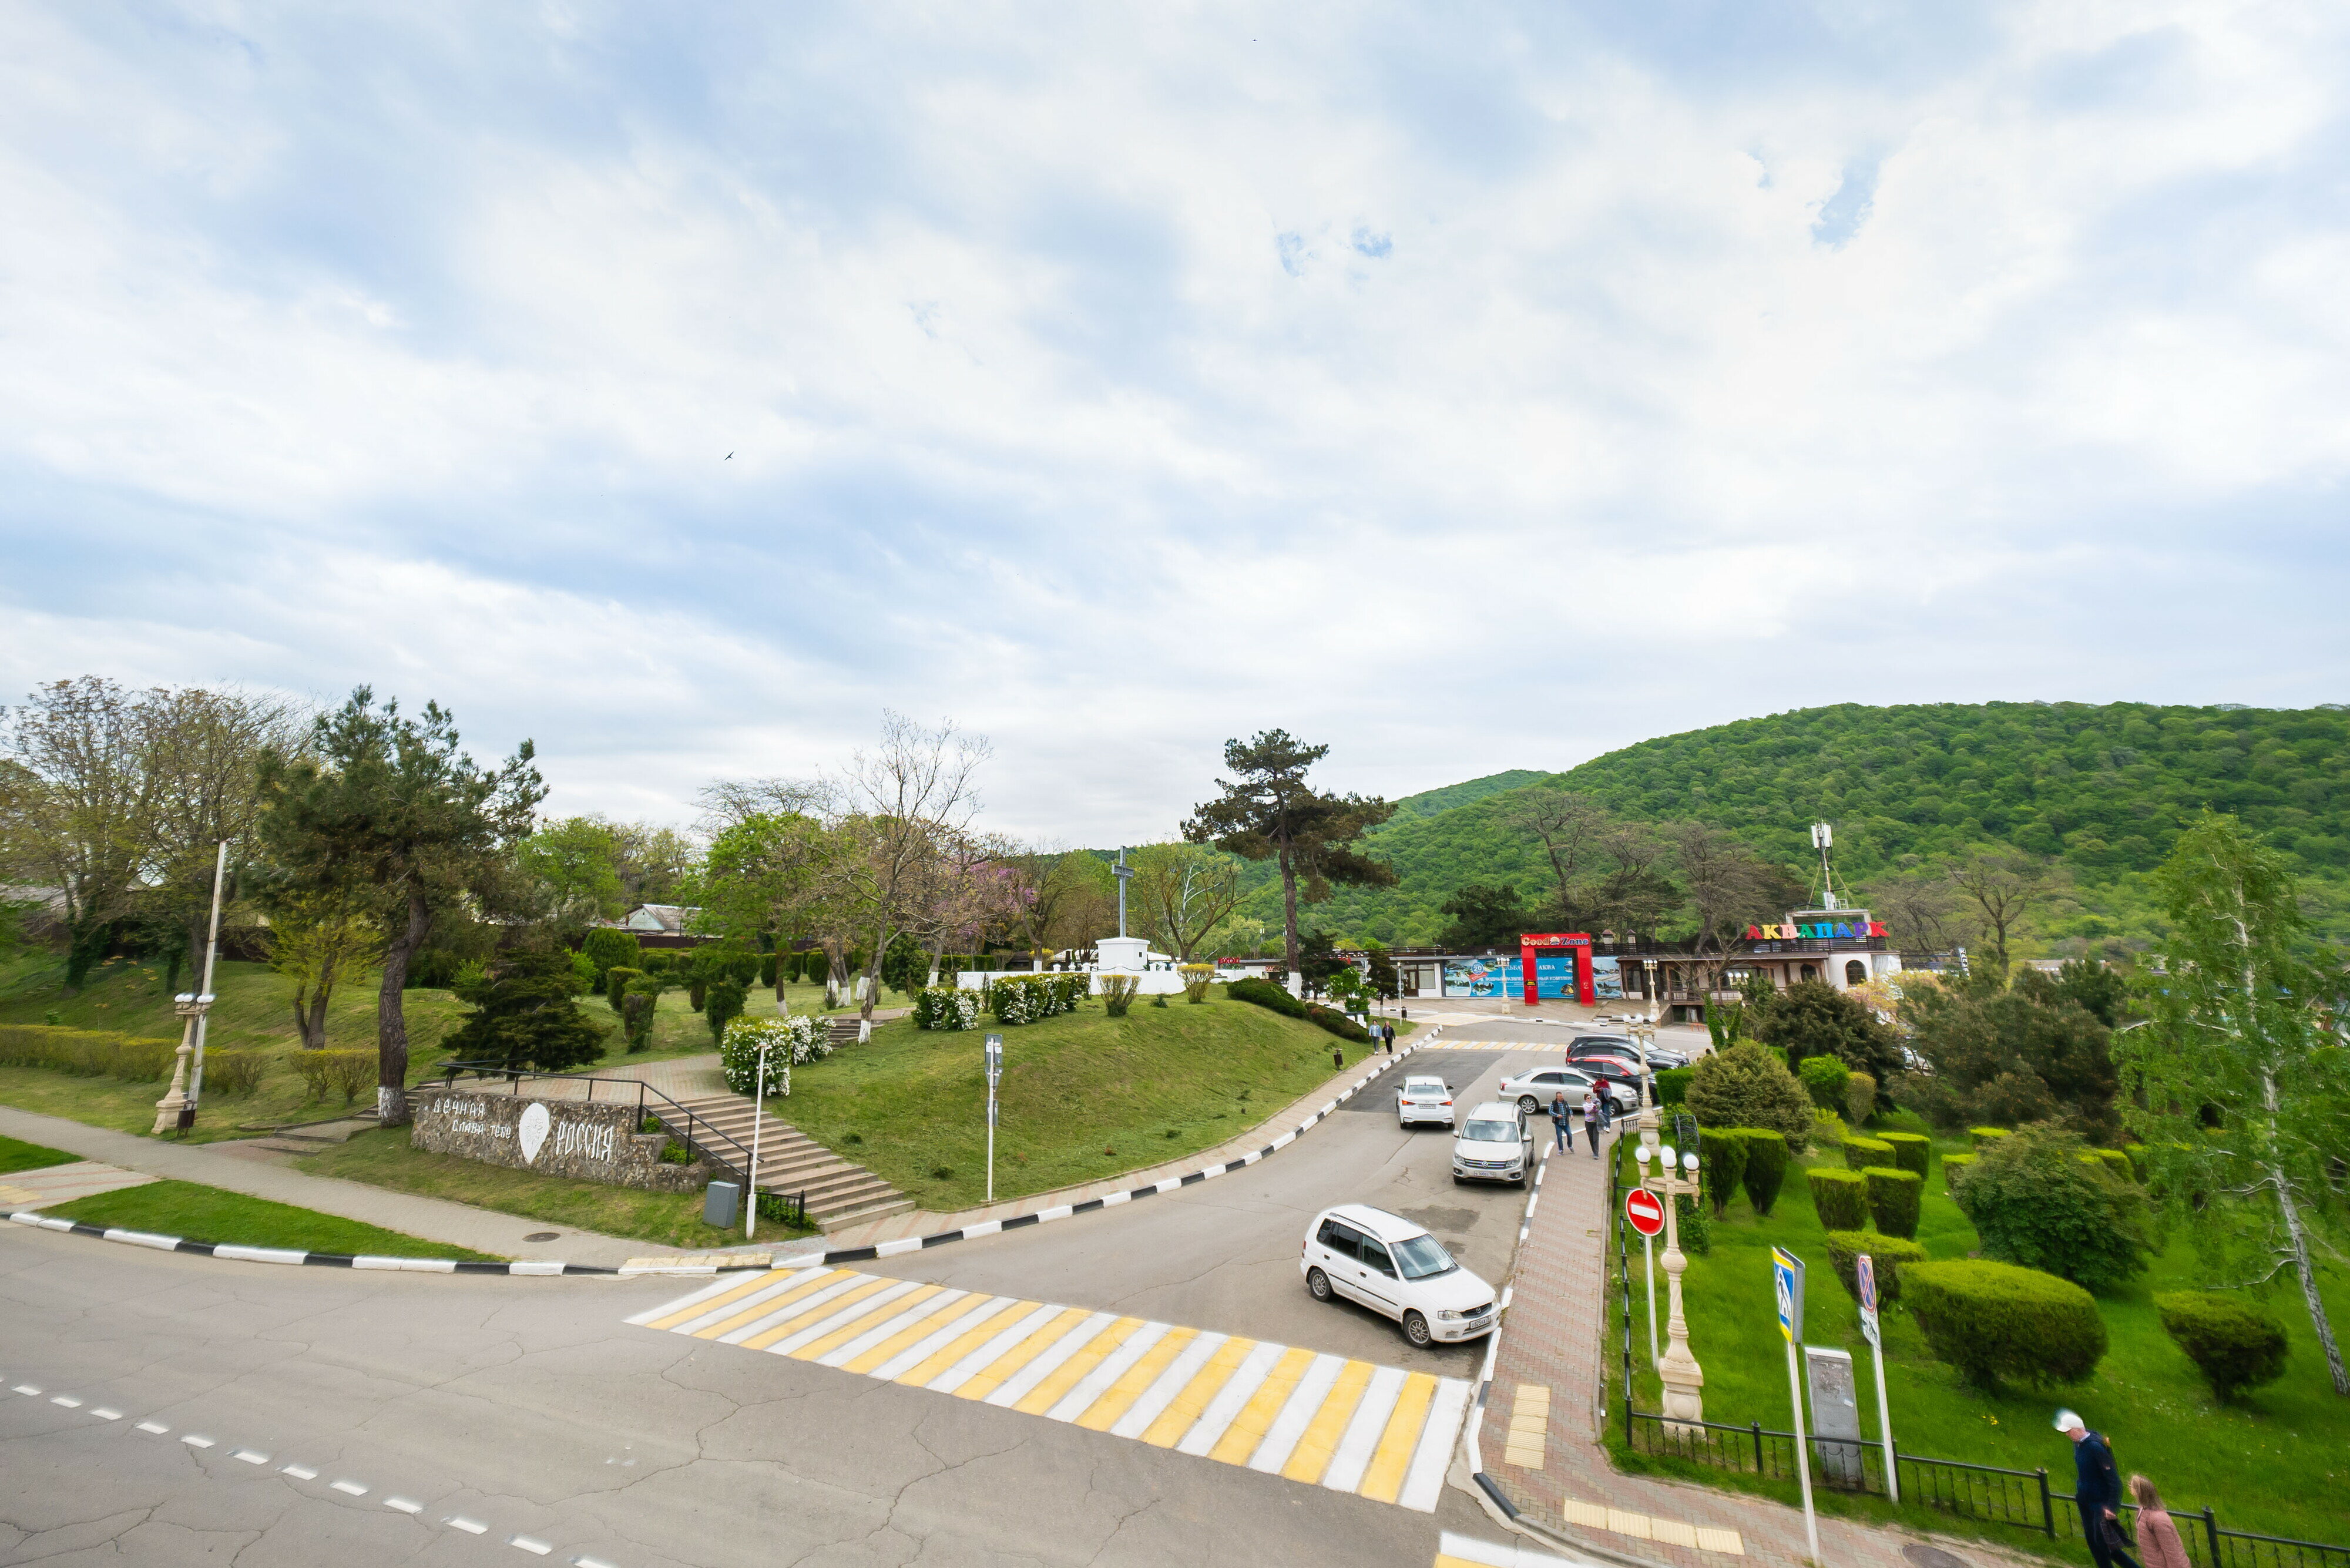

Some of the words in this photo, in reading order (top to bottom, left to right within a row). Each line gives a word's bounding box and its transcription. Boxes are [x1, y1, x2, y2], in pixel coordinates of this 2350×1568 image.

[1745, 922, 1890, 940] АКВАПАРК
[1522, 937, 1550, 946] Good
[1561, 937, 1589, 946] Zone
[556, 1122, 613, 1163] РОССИЯ
